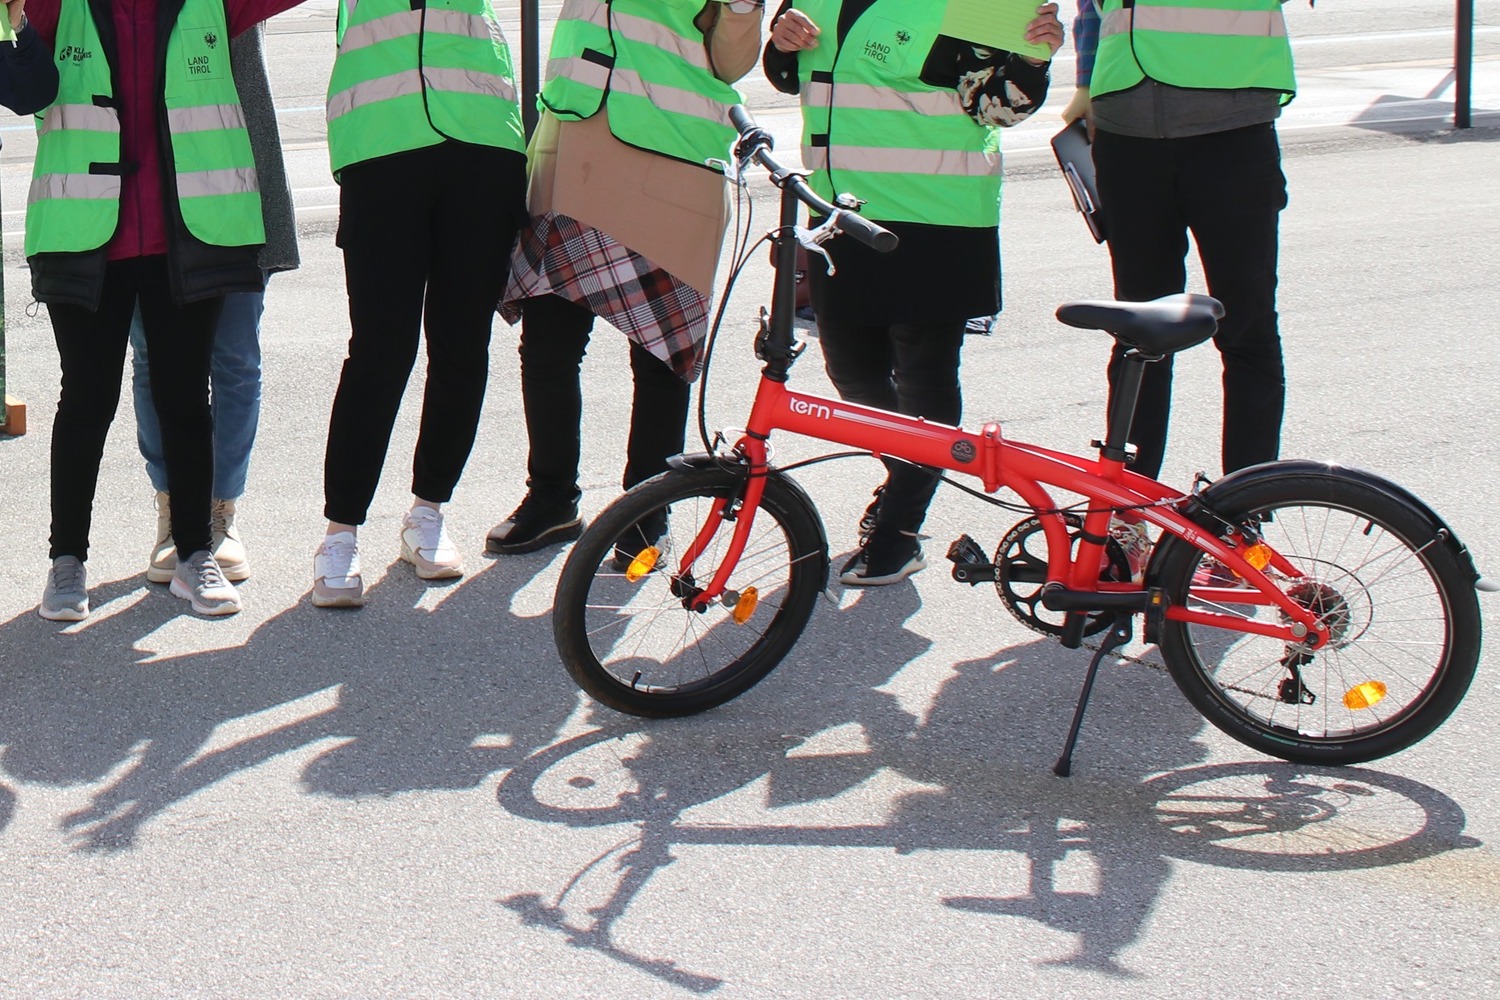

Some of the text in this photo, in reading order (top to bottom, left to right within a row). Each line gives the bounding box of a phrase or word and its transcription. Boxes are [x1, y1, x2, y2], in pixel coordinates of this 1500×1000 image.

[866, 40, 890, 54] LAND
[187, 56, 210, 66] LAND
[864, 47, 888, 64] TIROL
[188, 64, 211, 74] TIROL
[789, 396, 831, 420] tern
